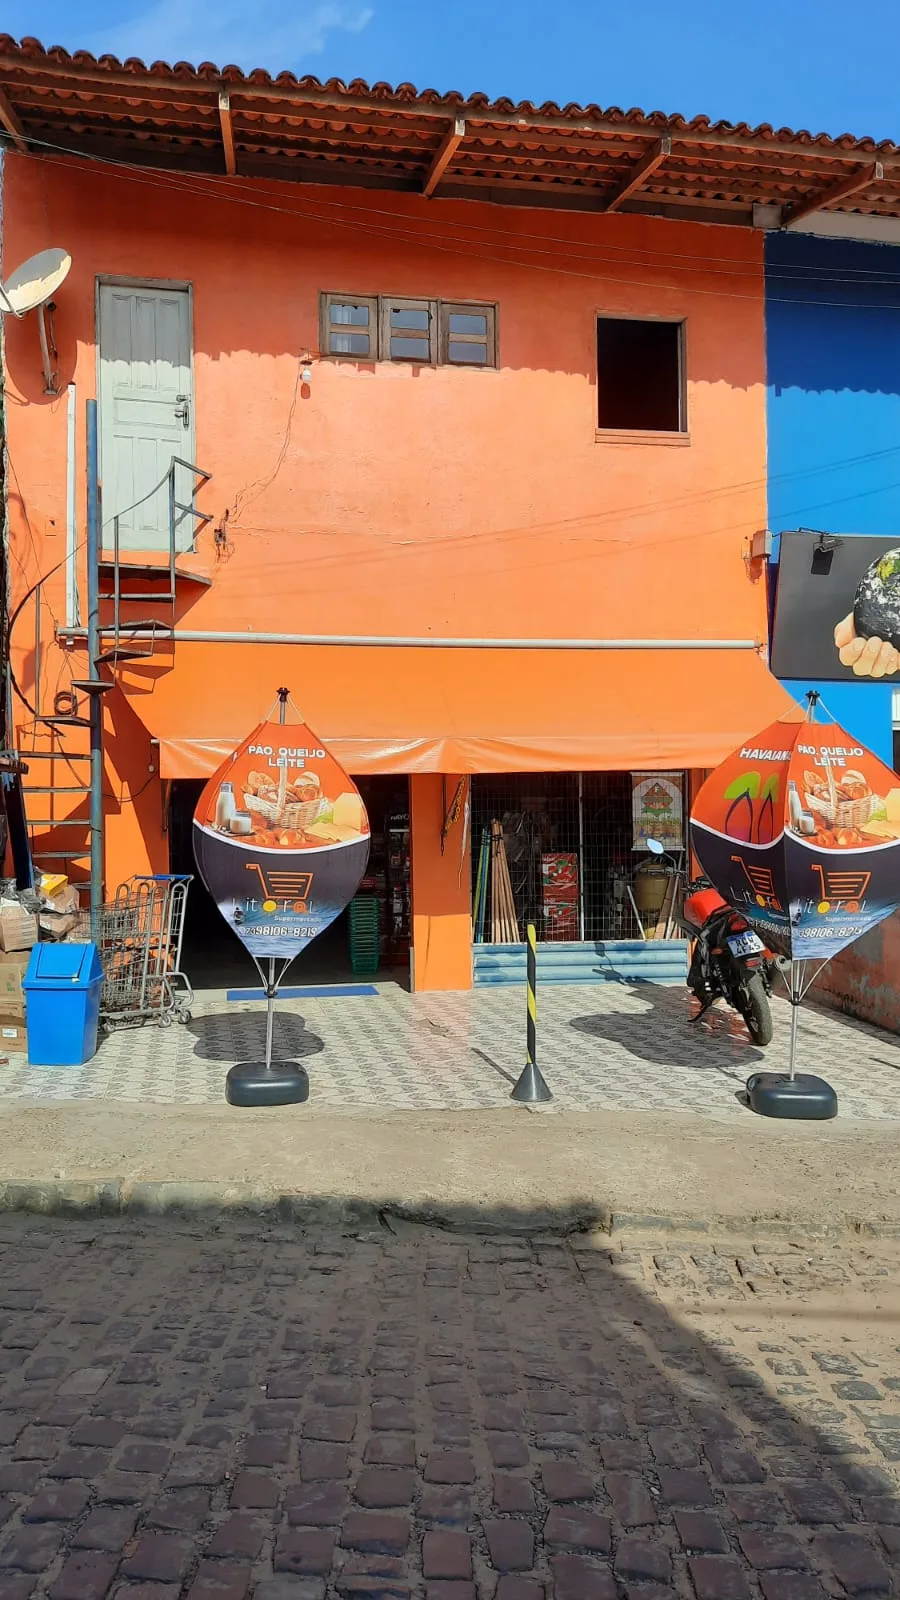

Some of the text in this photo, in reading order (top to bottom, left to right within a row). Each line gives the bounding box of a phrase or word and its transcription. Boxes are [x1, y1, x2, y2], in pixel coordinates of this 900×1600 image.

[278, 747, 326, 759] QUEIJO
[820, 746, 864, 757] QUEIJO
[268, 757, 305, 768] LEITE
[813, 756, 846, 767] LEITE
